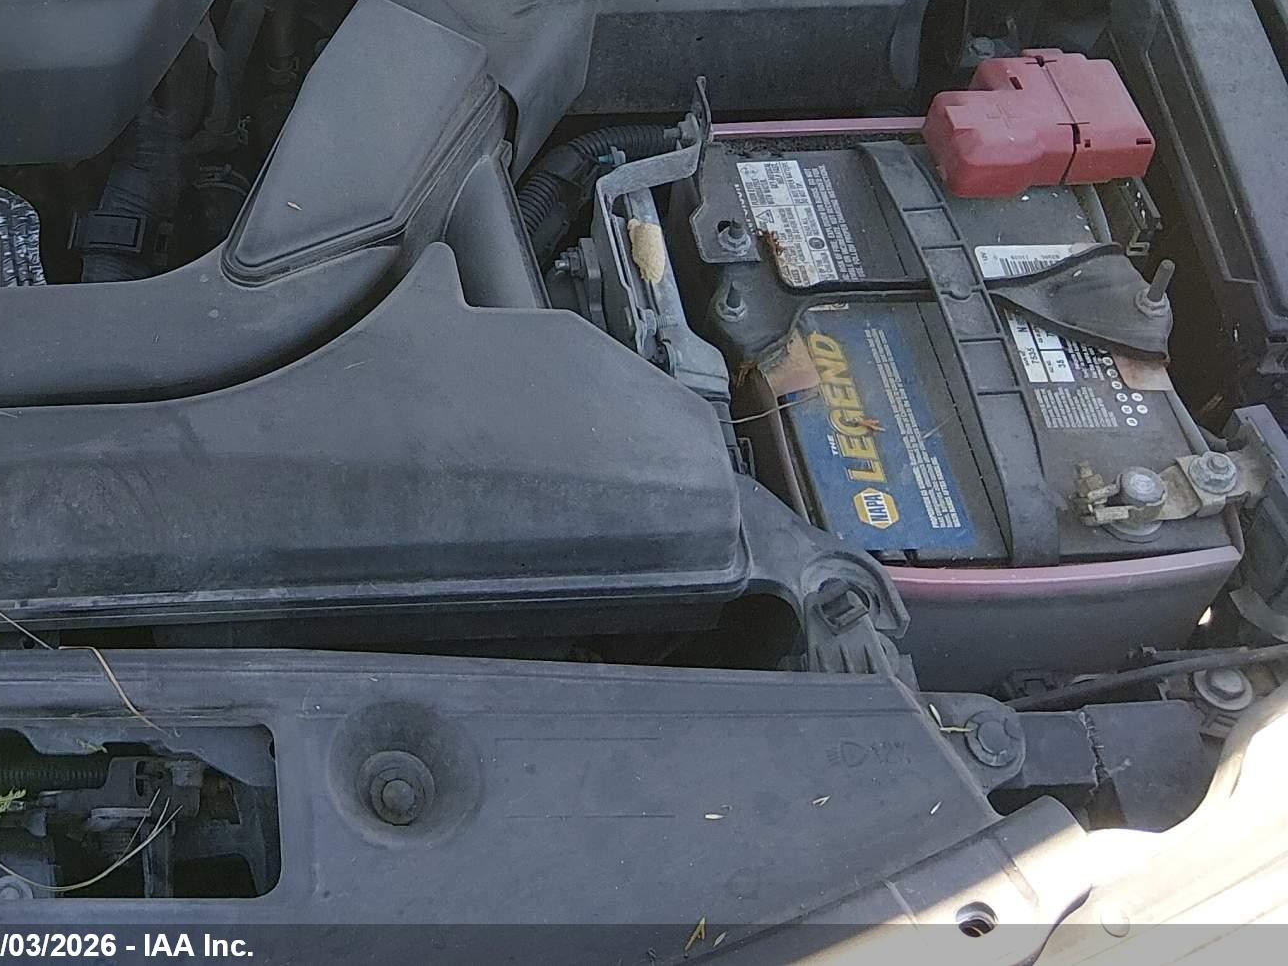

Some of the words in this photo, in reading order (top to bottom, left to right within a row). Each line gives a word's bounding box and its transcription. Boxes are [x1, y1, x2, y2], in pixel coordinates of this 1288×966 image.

[807, 330, 888, 483] LEGEND
[827, 434, 840, 456] THE
[867, 492, 890, 525] NAPA
